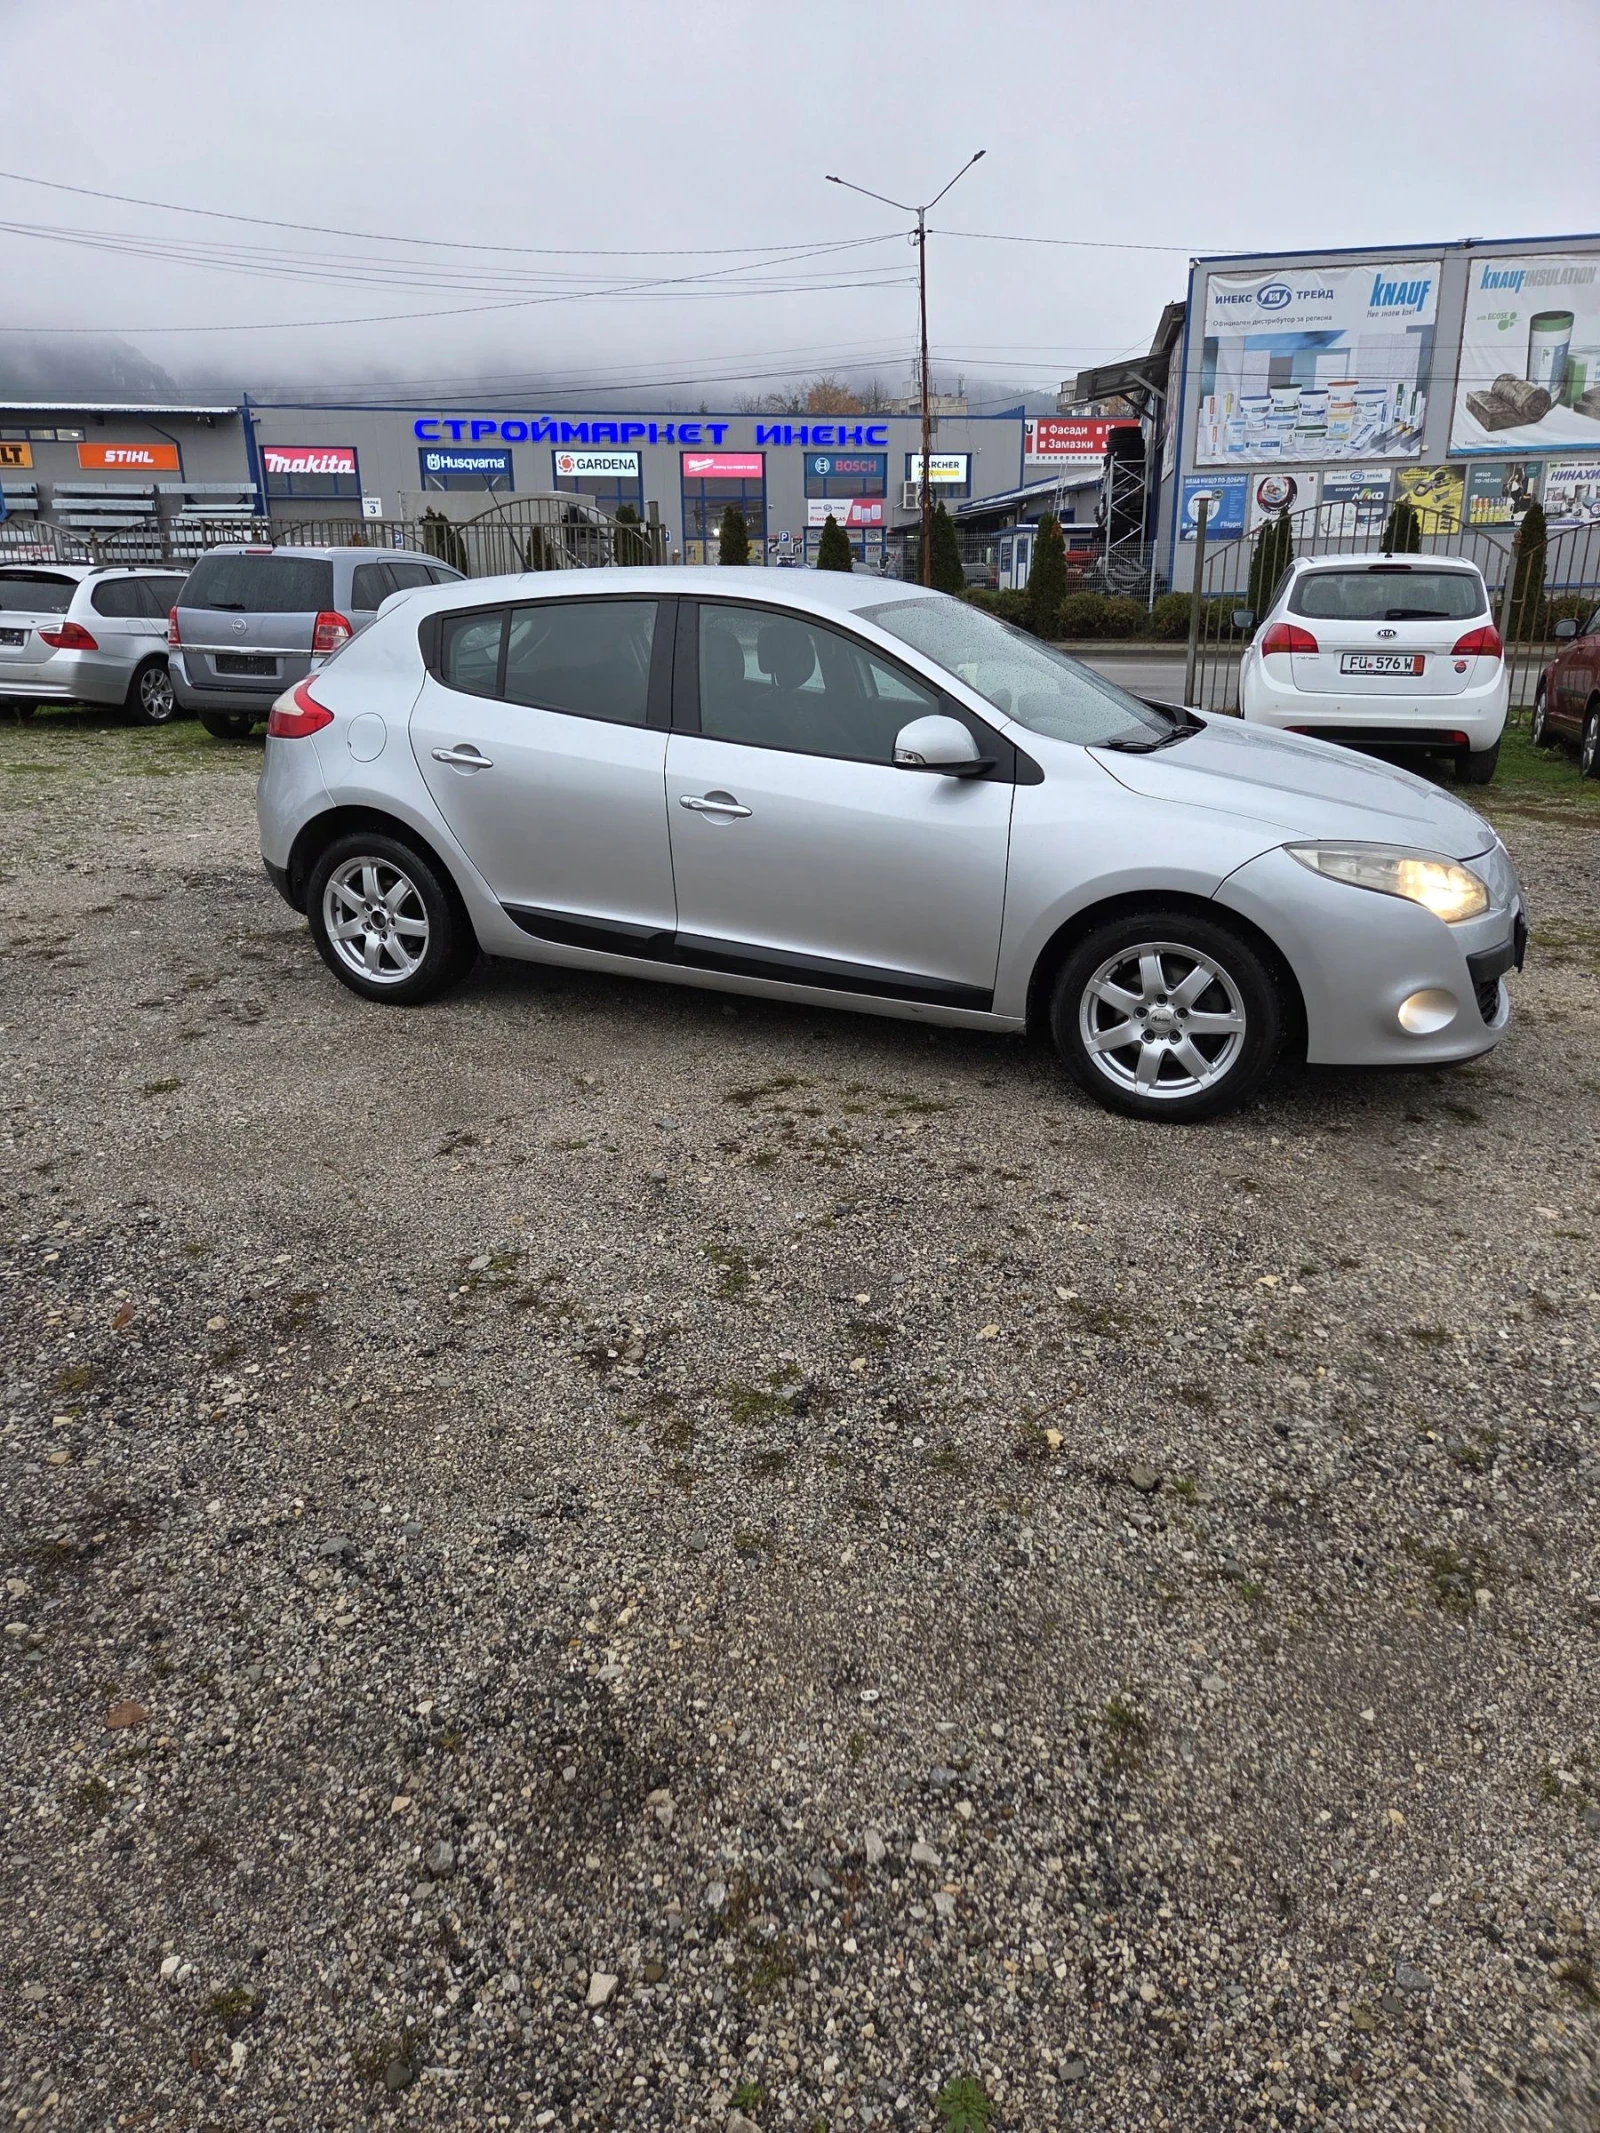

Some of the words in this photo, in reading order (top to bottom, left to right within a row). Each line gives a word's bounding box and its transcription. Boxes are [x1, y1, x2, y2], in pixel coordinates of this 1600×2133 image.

[1215, 294, 1252, 304] ИНЕКС
[1296, 289, 1334, 301] ТРЕЙД
[1369, 273, 1432, 311] KNAUF
[414, 416, 729, 445] СТРОЙМАРКЕТ
[756, 424, 888, 446] ИНЕКС
[1049, 424, 1088, 436] Фасади
[1048, 438, 1094, 449] Замазки
[104, 450, 155, 464] STIHL
[440, 456, 505, 471] Husqvarna
[576, 458, 636, 471] GARDENA
[835, 460, 877, 472] BOSCH
[369, 505, 377, 515] 3
[781, 533, 788, 542] P
[1349, 656, 1369, 669] FÜ
[1375, 657, 1401, 670] 576
[1403, 657, 1414, 670] W
